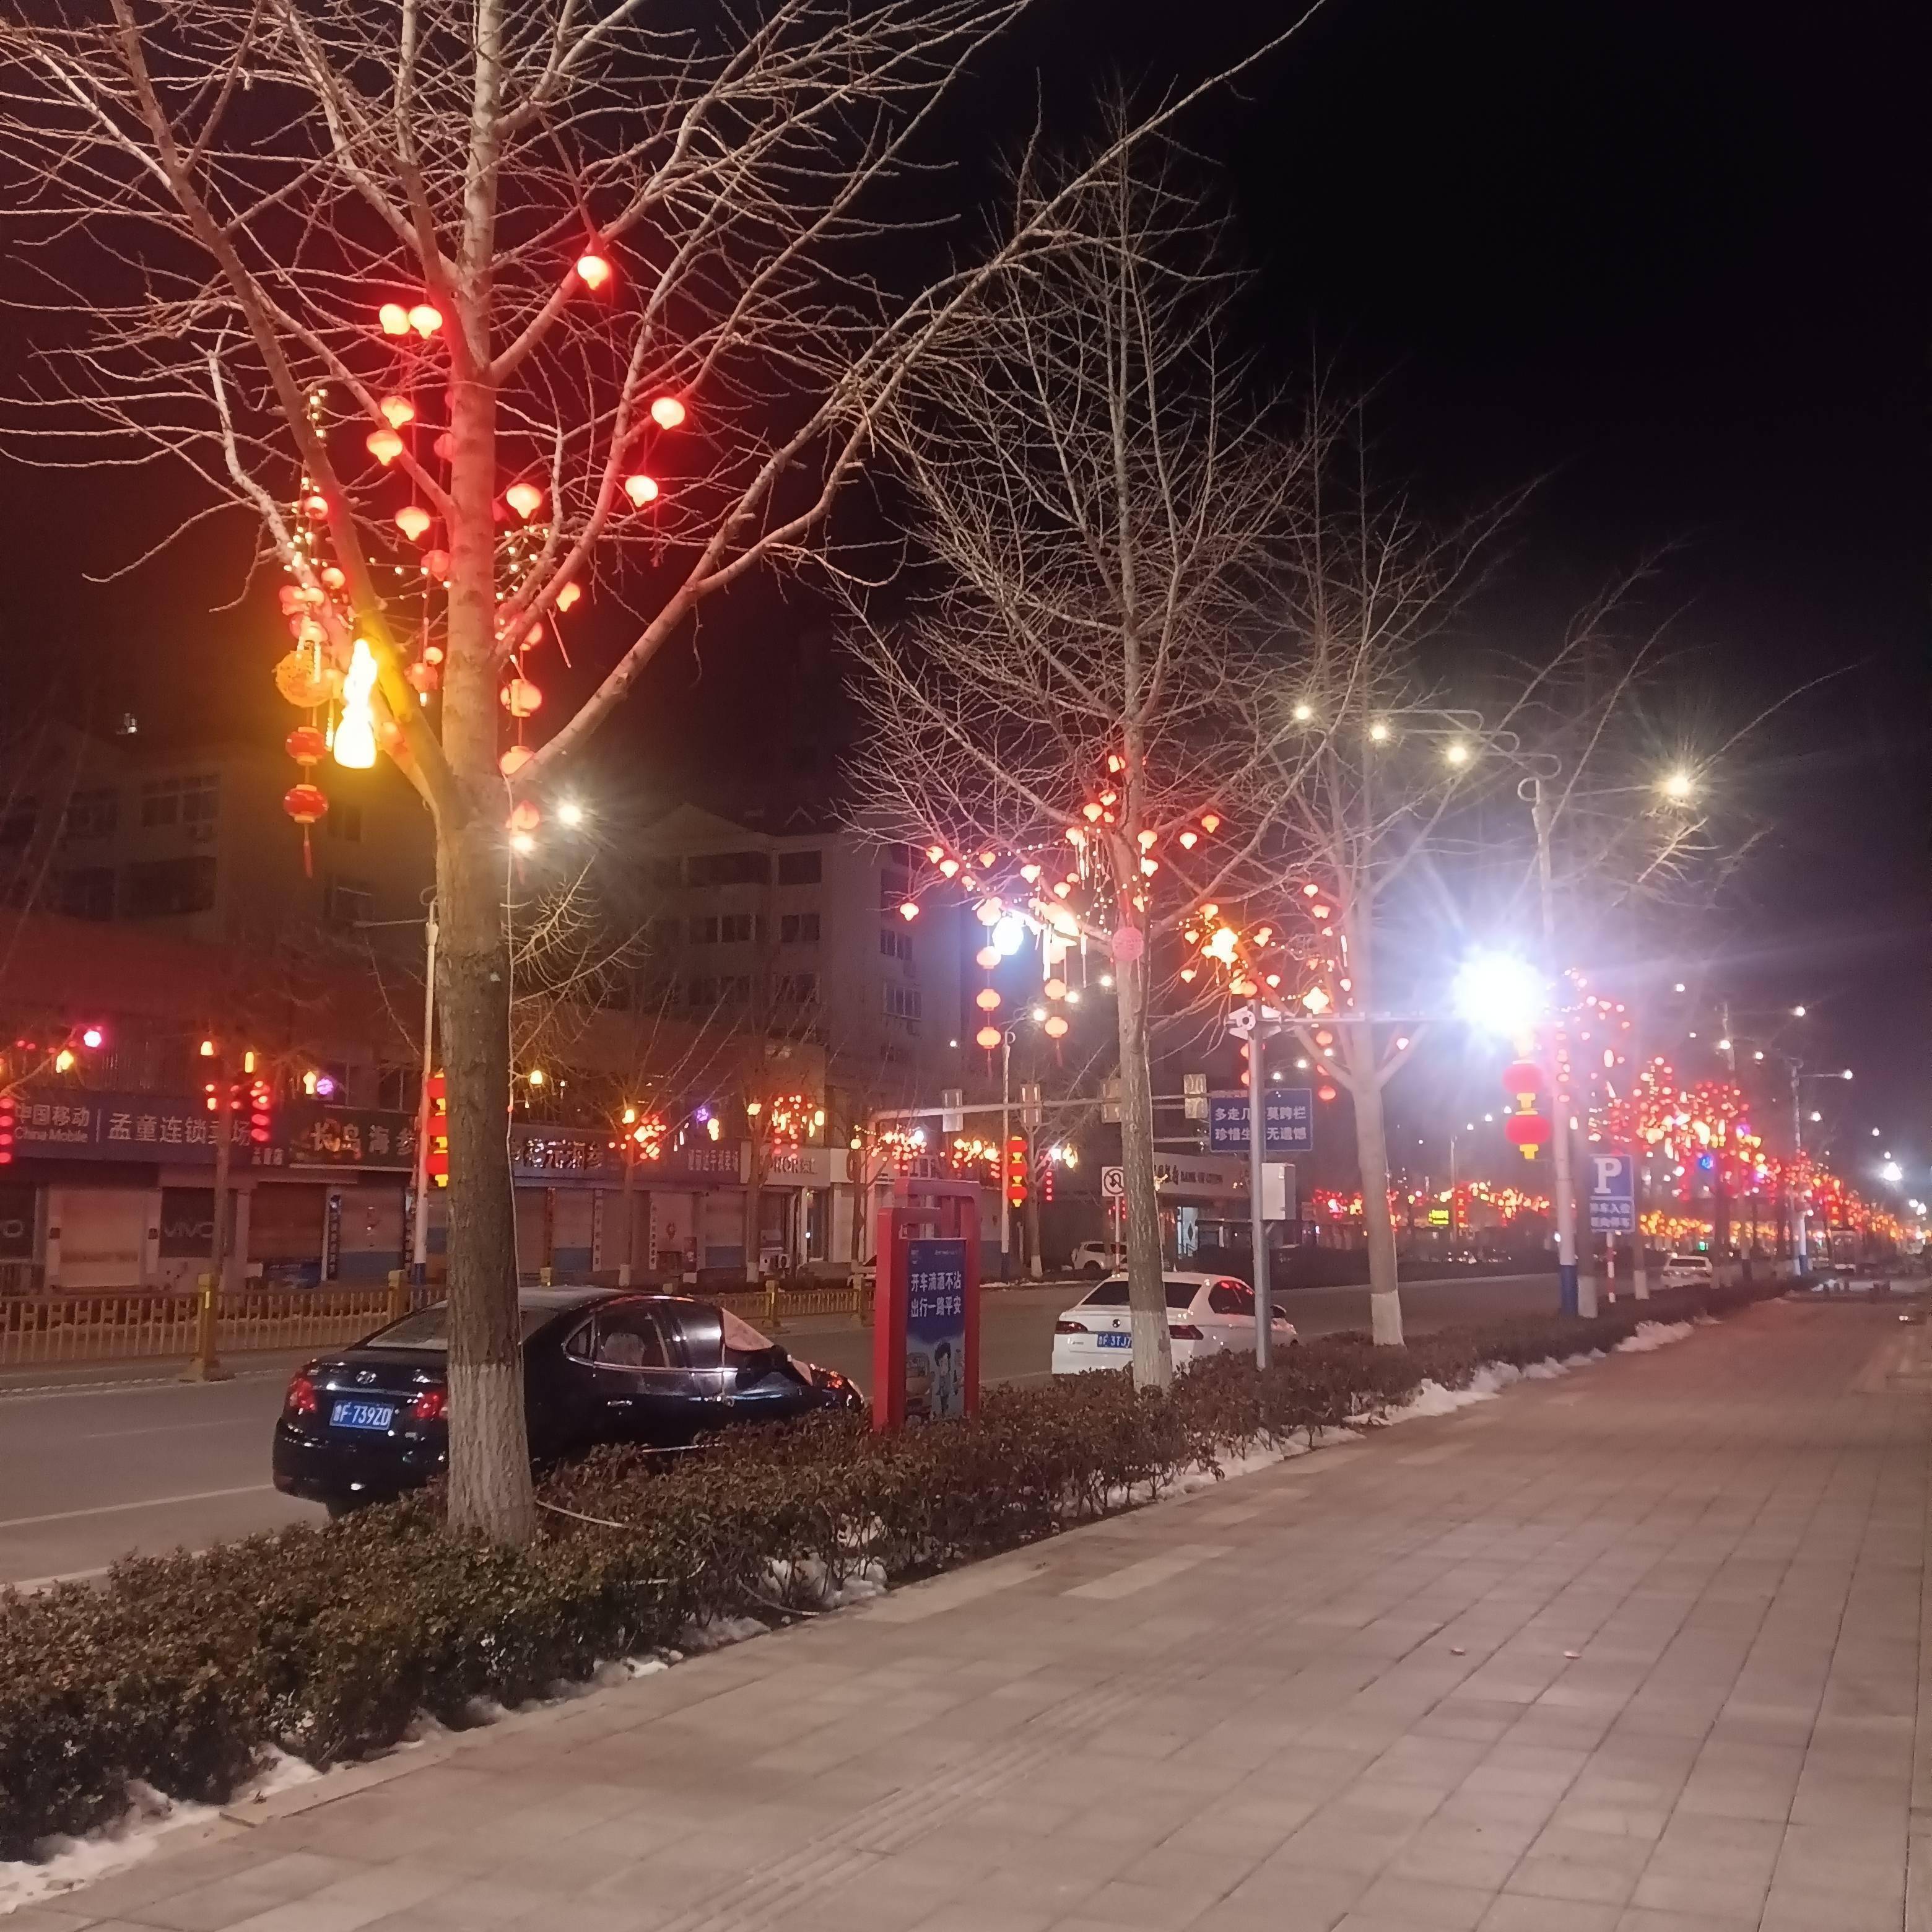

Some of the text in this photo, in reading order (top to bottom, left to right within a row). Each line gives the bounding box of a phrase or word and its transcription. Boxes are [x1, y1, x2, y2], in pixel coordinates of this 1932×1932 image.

[14, 1103, 90, 1126] 中国移动
[1215, 1106, 1307, 1121] 多走几莫跨栏
[1215, 1127, 1307, 1141] 珍惜生无遗憾
[1594, 1158, 1622, 1194] P
[911, 1271, 962, 1292] 开车滴酒不沾
[911, 1296, 962, 1318] 出行一路平安
